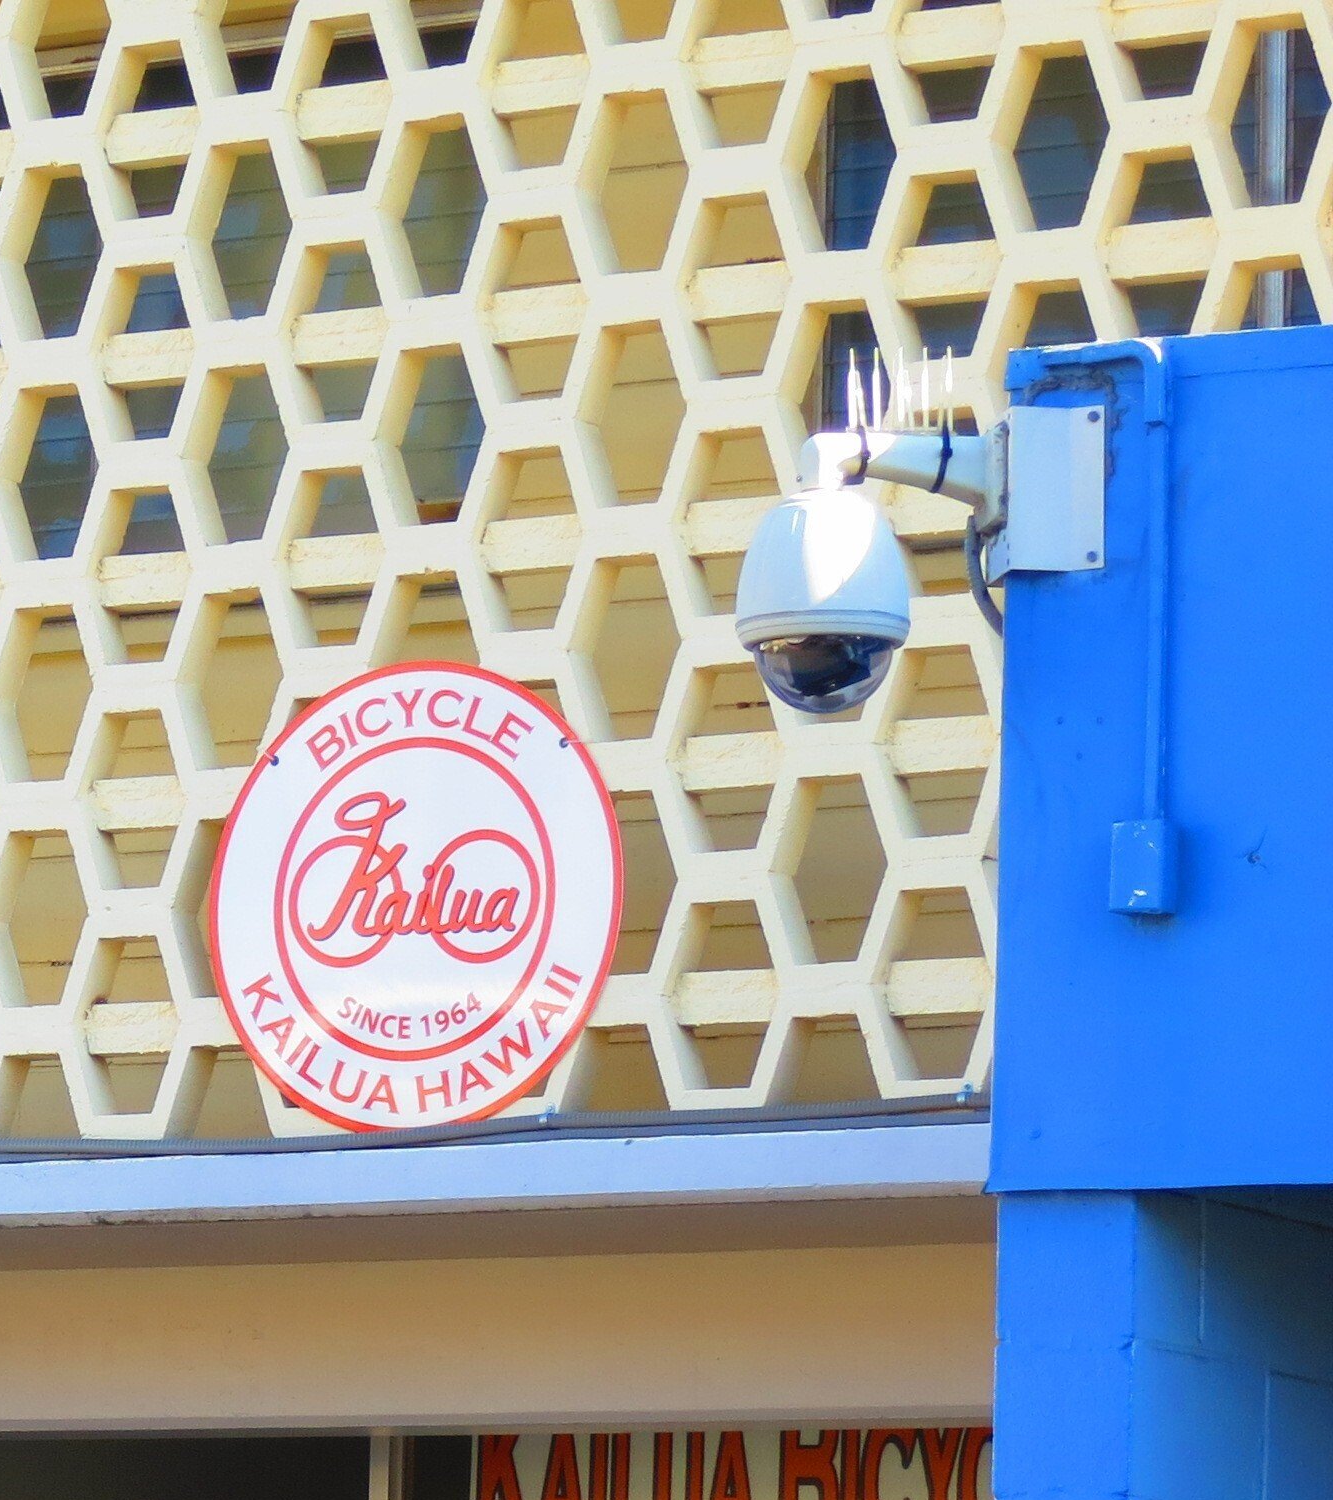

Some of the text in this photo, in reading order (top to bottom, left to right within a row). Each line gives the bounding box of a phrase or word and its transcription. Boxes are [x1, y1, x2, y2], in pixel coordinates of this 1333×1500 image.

[305, 688, 536, 773] BICYCLE
[306, 790, 521, 942] Kailua
[241, 961, 584, 1116] KAILUA HAWAII
[337, 991, 483, 1040] SINCE 1964
